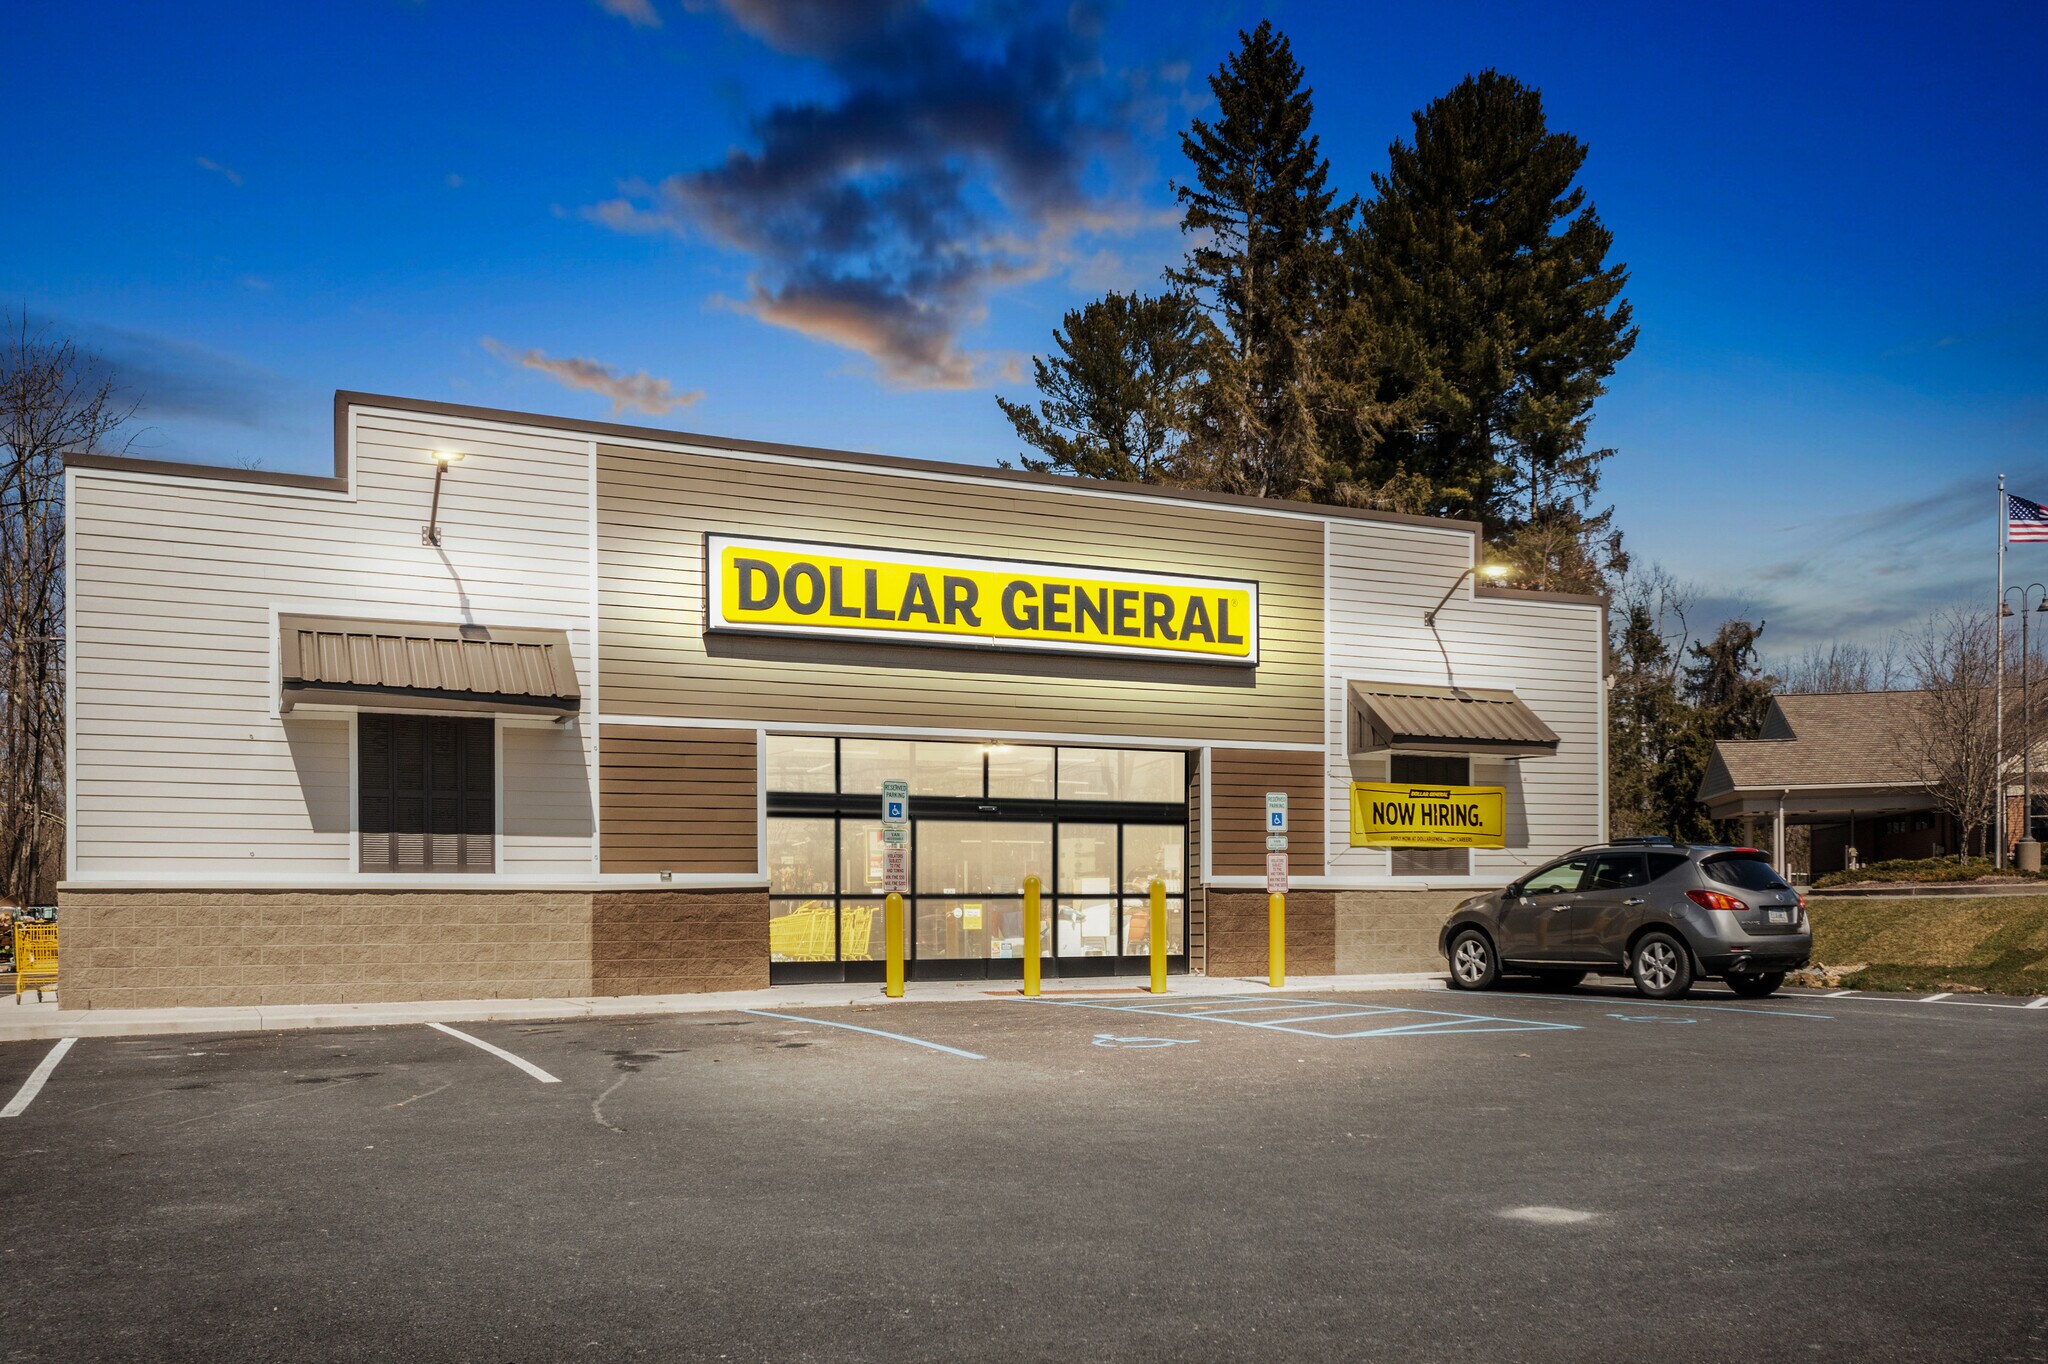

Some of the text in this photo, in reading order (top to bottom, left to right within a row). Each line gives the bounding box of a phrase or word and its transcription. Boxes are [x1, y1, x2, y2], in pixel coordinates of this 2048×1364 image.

[733, 558, 1243, 645] DOLLAR GENERAL
[1373, 802, 1483, 827] NOW HIRING.
